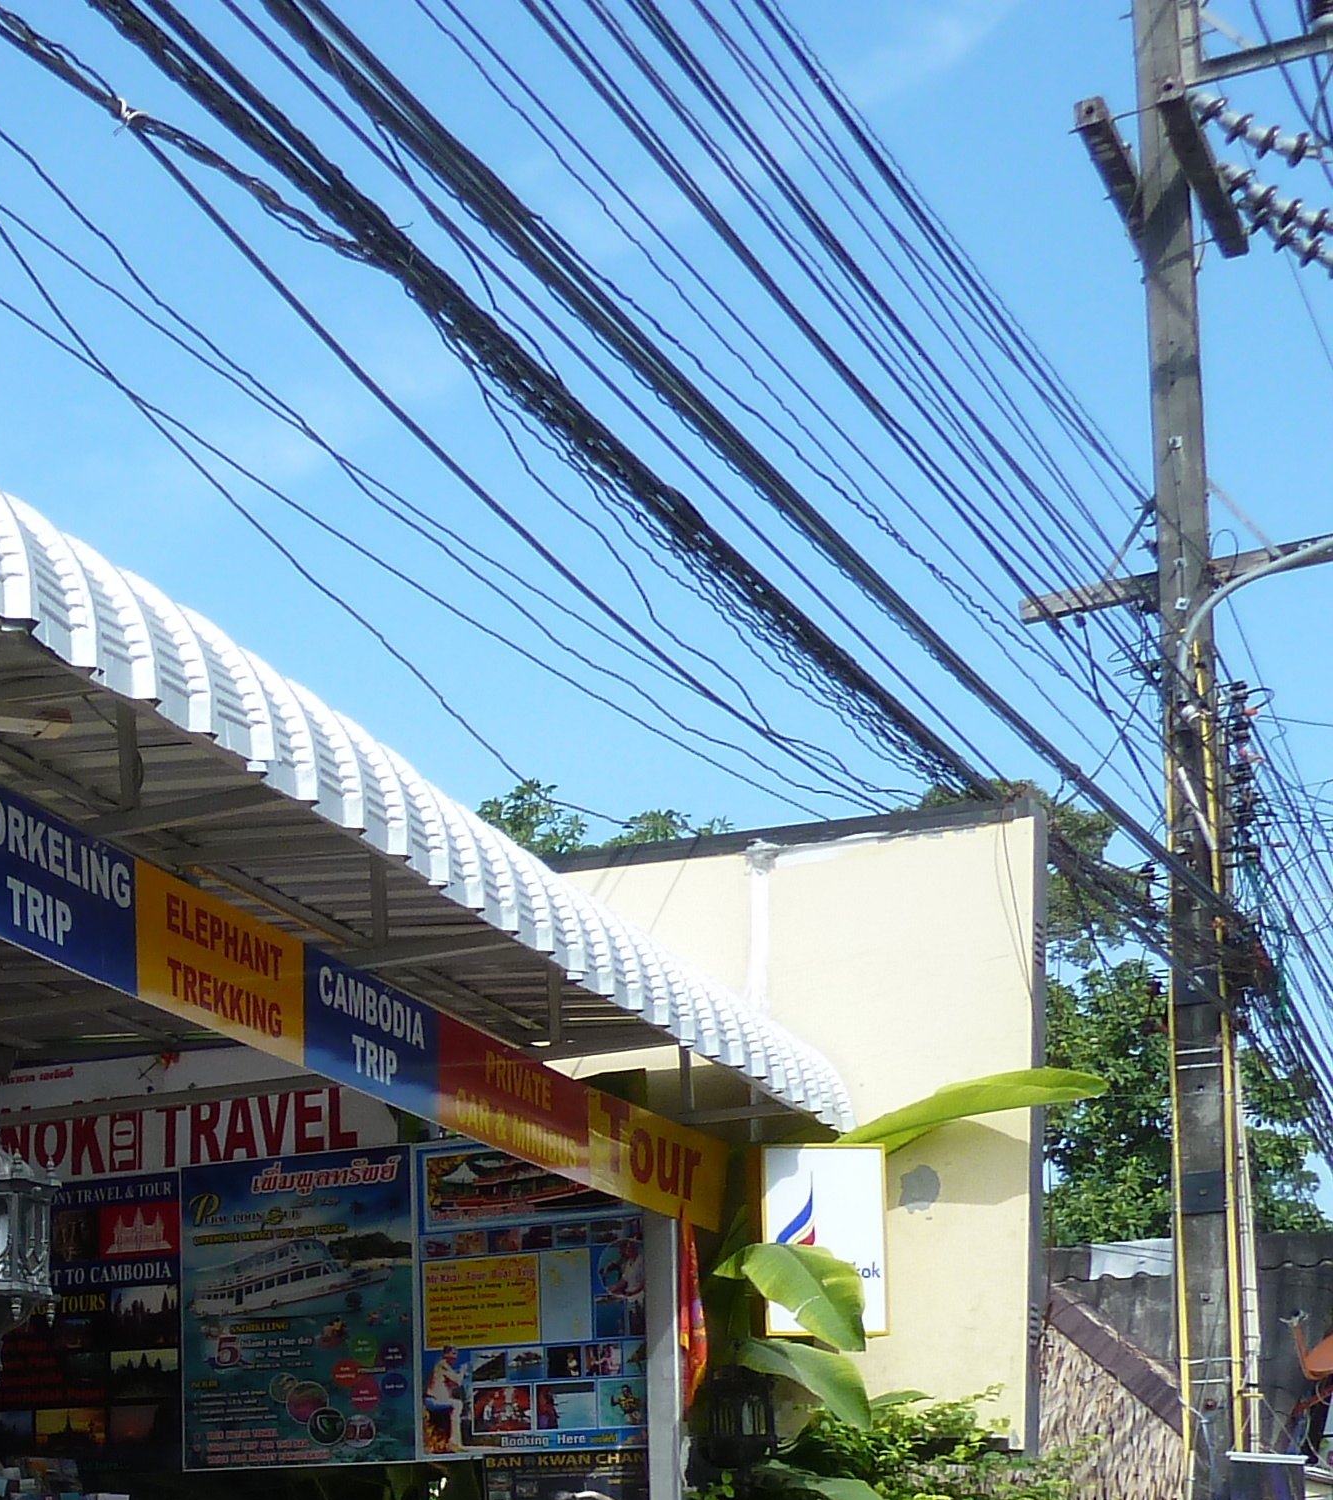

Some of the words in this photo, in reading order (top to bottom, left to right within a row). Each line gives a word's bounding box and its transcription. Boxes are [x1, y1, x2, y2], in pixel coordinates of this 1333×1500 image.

[6, 875, 73, 947] TRIP
[165, 892, 284, 982] ELEPHANT
[167, 957, 284, 1039] TREKKING
[318, 966, 427, 1051] CAMBODIA
[352, 1034, 398, 1086] TRIP
[486, 1051, 552, 1111] PRIVATE
[1, 1101, 105, 1175] NOK
[156, 1088, 358, 1168] TRAVEL
[456, 1089, 491, 1135] CAR
[495, 1112, 507, 1140] &
[512, 1117, 577, 1169] MINIBUS
[601, 1100, 701, 1201] Tour
[76, 1187, 123, 1203] TRAVEL
[125, 1188, 134, 1199] &
[137, 1181, 172, 1198] TOUR
[61, 1293, 107, 1314] TOURS
[65, 1270, 84, 1285] TO
[90, 1261, 172, 1284] CAMBODIA
[216, 1335, 241, 1366] 5
[486, 1454, 522, 1469] BAN
[537, 1453, 591, 1467] KWAN
[501, 1434, 549, 1448] Booking
[557, 1433, 586, 1445] Here
